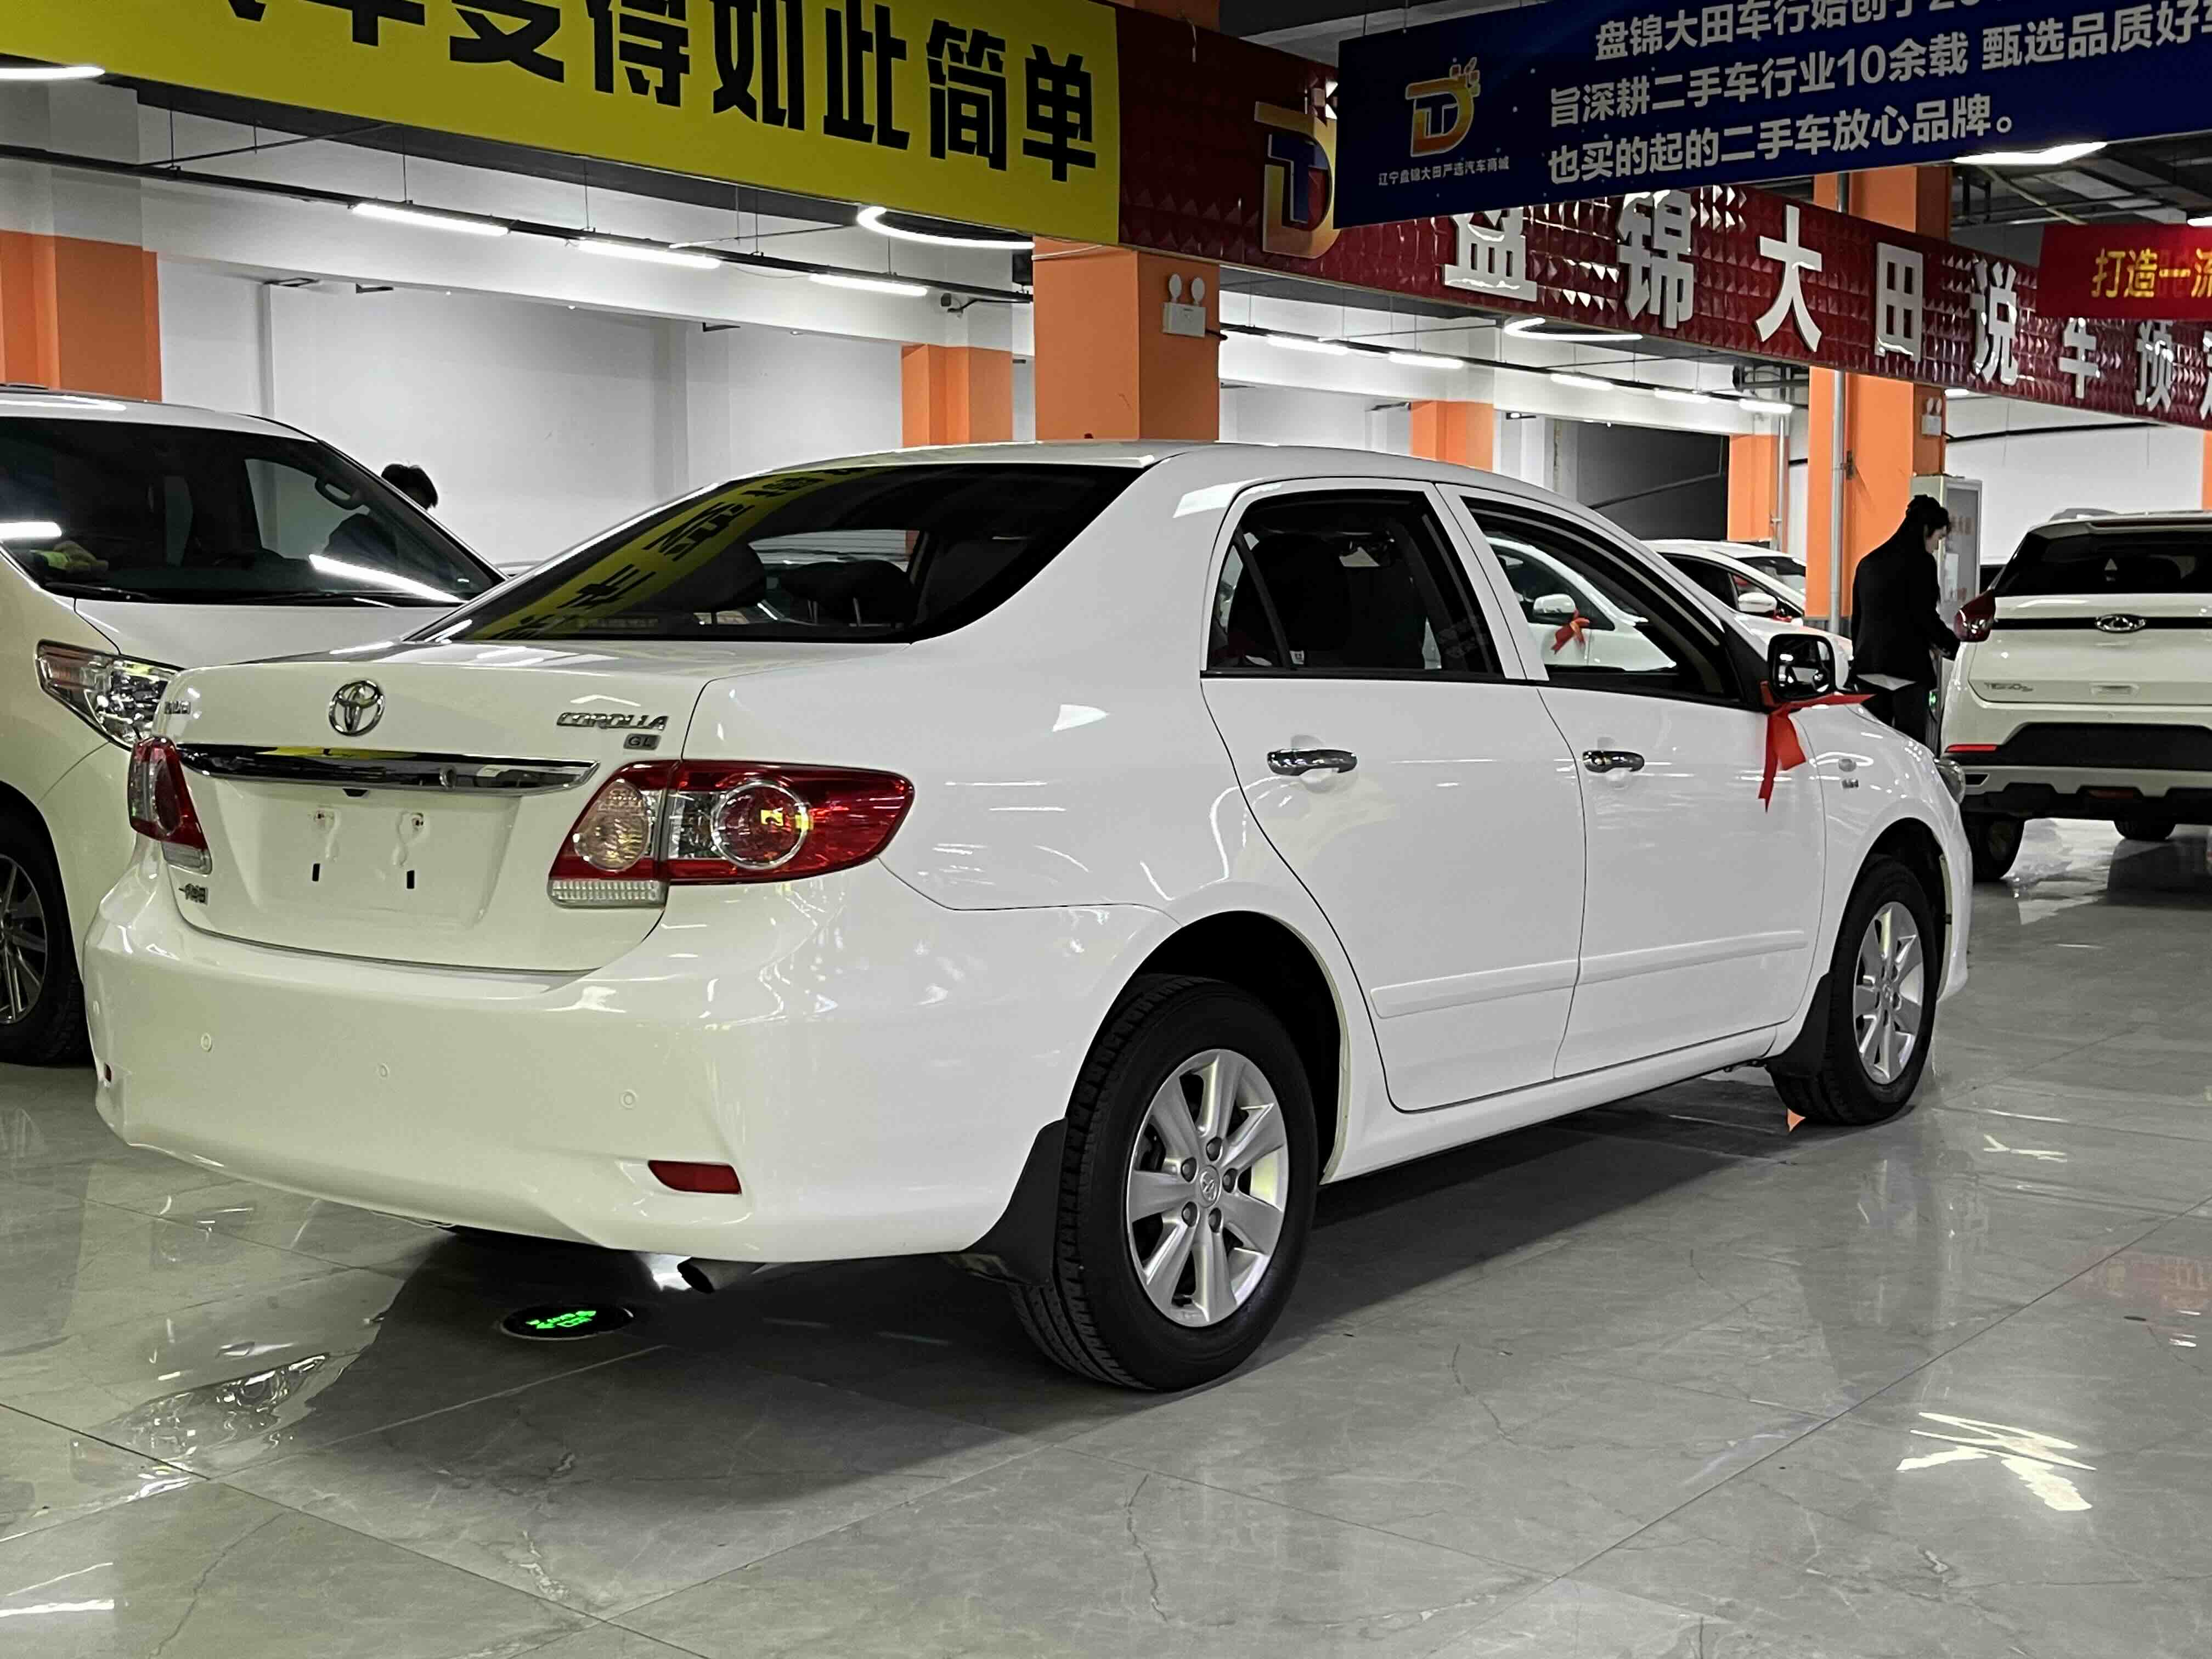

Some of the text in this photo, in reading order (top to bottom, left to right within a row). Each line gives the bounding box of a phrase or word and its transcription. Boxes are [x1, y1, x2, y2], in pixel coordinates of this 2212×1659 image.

[228, 0, 1096, 182] 得如此简单
[1550, 0, 2212, 127] 旨深耕二手车行业10余载 甄选品质好
[1548, 93, 2012, 184] 也买的起的二手车放心品牌。
